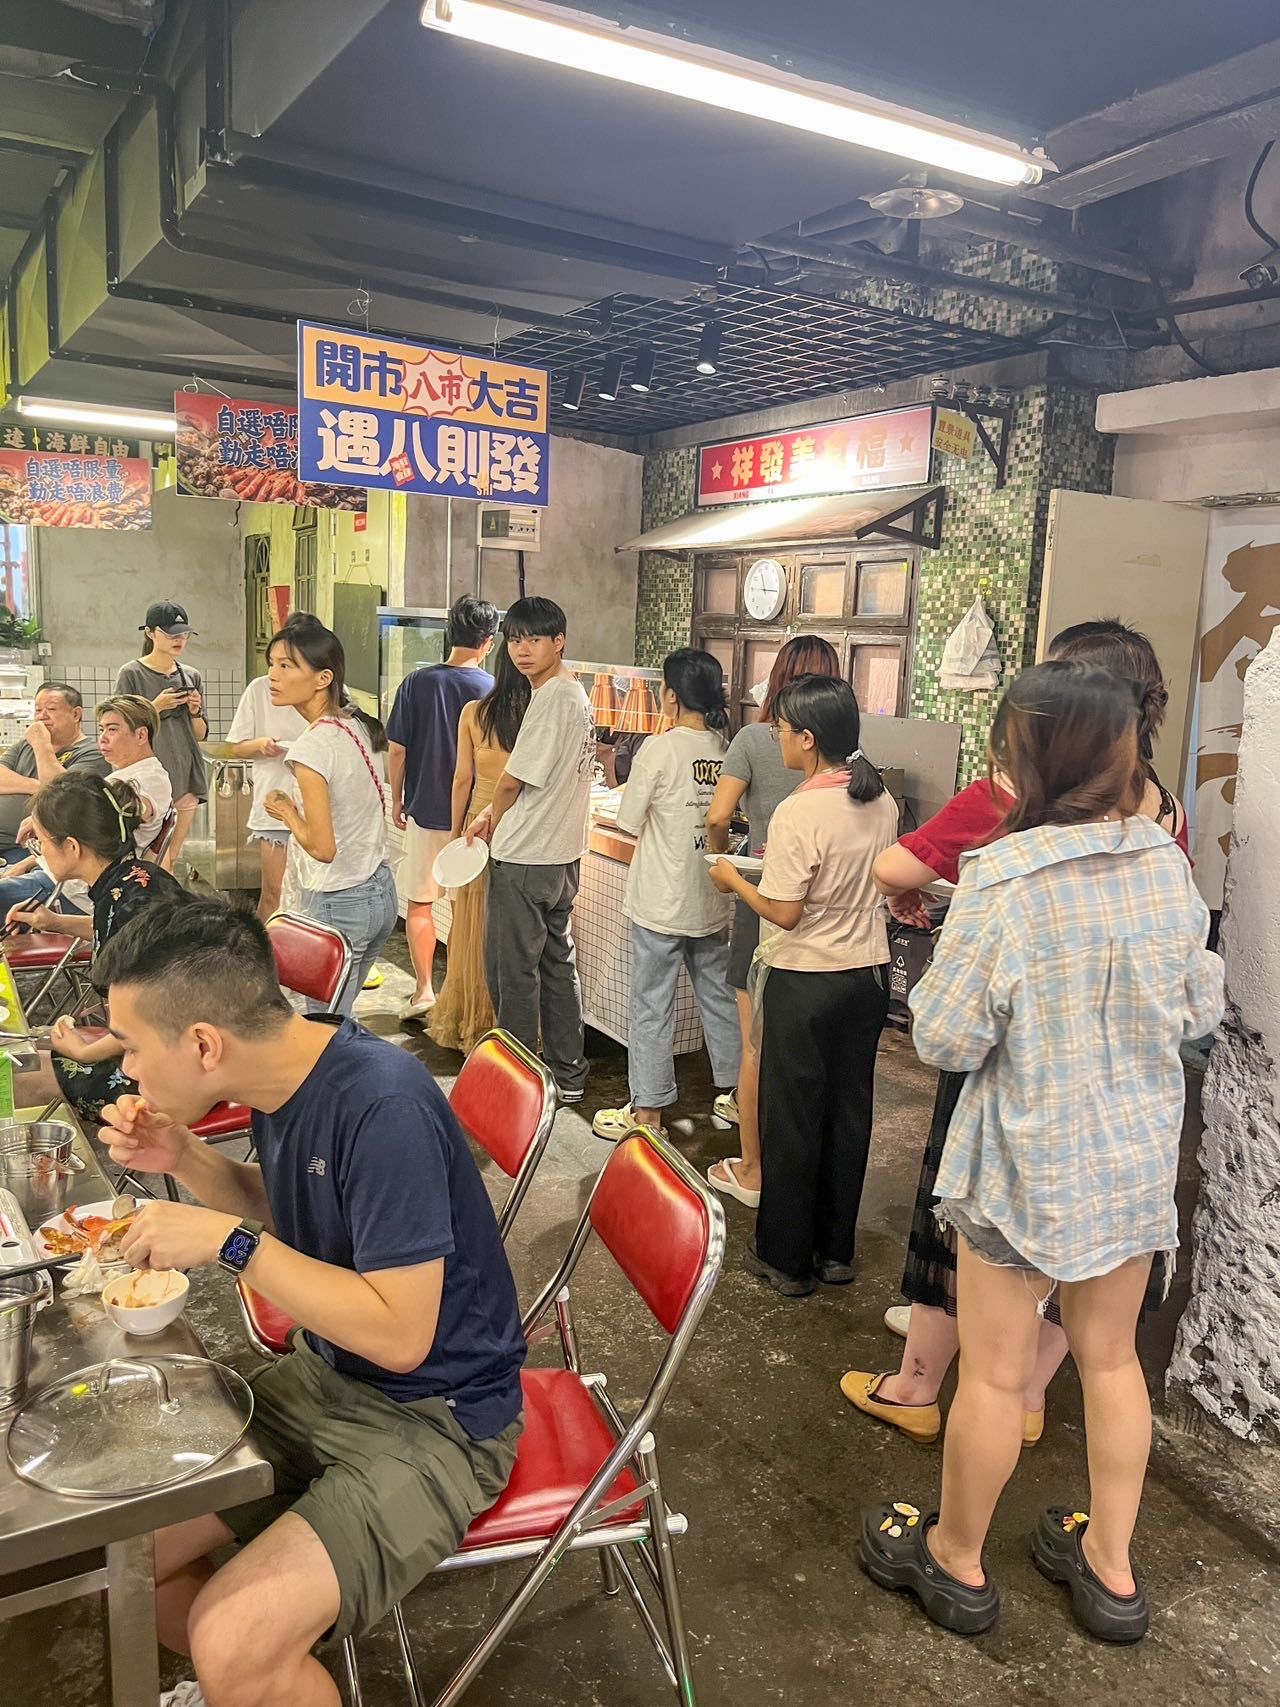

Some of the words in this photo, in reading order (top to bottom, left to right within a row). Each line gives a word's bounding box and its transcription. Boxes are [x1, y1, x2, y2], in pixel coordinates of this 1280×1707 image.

[316, 339, 403, 397] 開市
[409, 369, 464, 406] 八市
[467, 371, 541, 421] 大吉
[26, 456, 123, 481] 自選唔限量
[317, 408, 541, 495] 遇八則發
